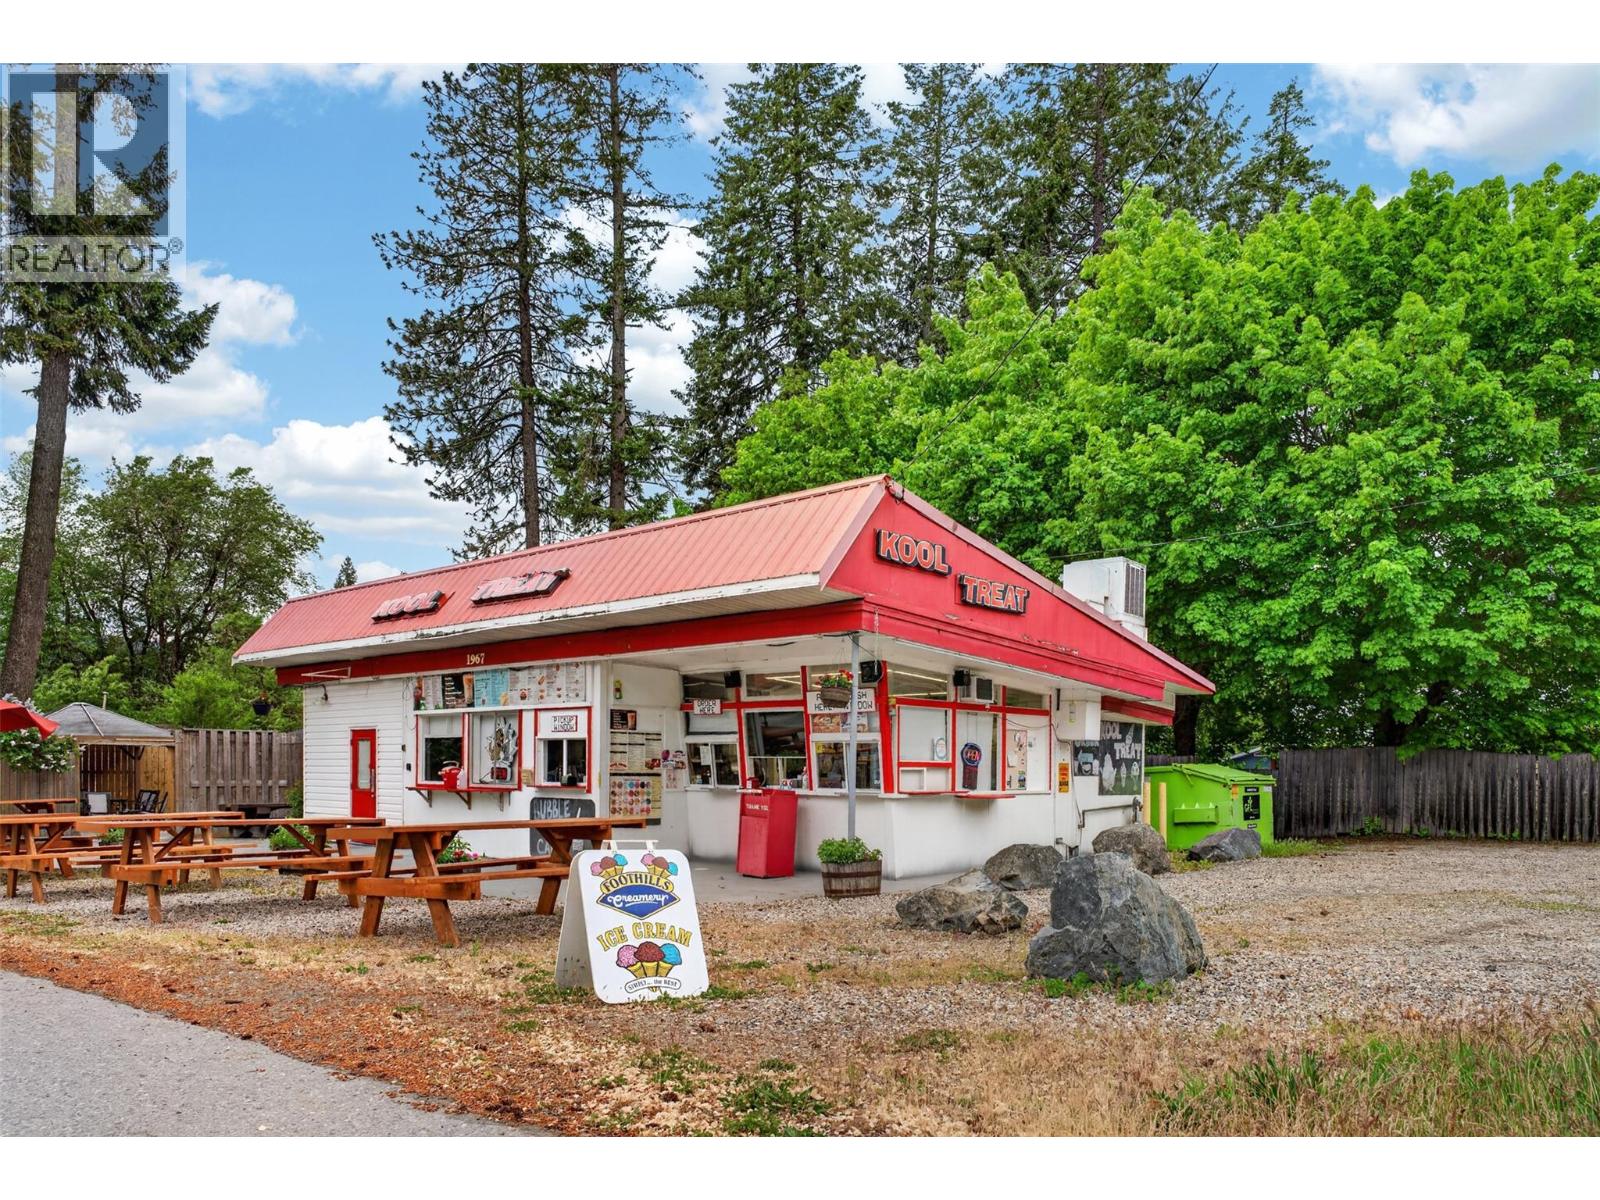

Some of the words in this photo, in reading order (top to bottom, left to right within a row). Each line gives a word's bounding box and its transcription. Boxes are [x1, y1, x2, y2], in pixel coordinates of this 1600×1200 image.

[879, 530, 950, 575] KOOL
[962, 575, 1029, 613] TREAT
[466, 653, 485, 665] 1967
[697, 699, 717, 707] ORDER
[553, 716, 575, 724] PICKUP
[603, 873, 670, 893] FOOTHILLS
[607, 893, 669, 908] Creamery
[596, 925, 628, 952] ICE
[632, 921, 694, 947] CREAM
